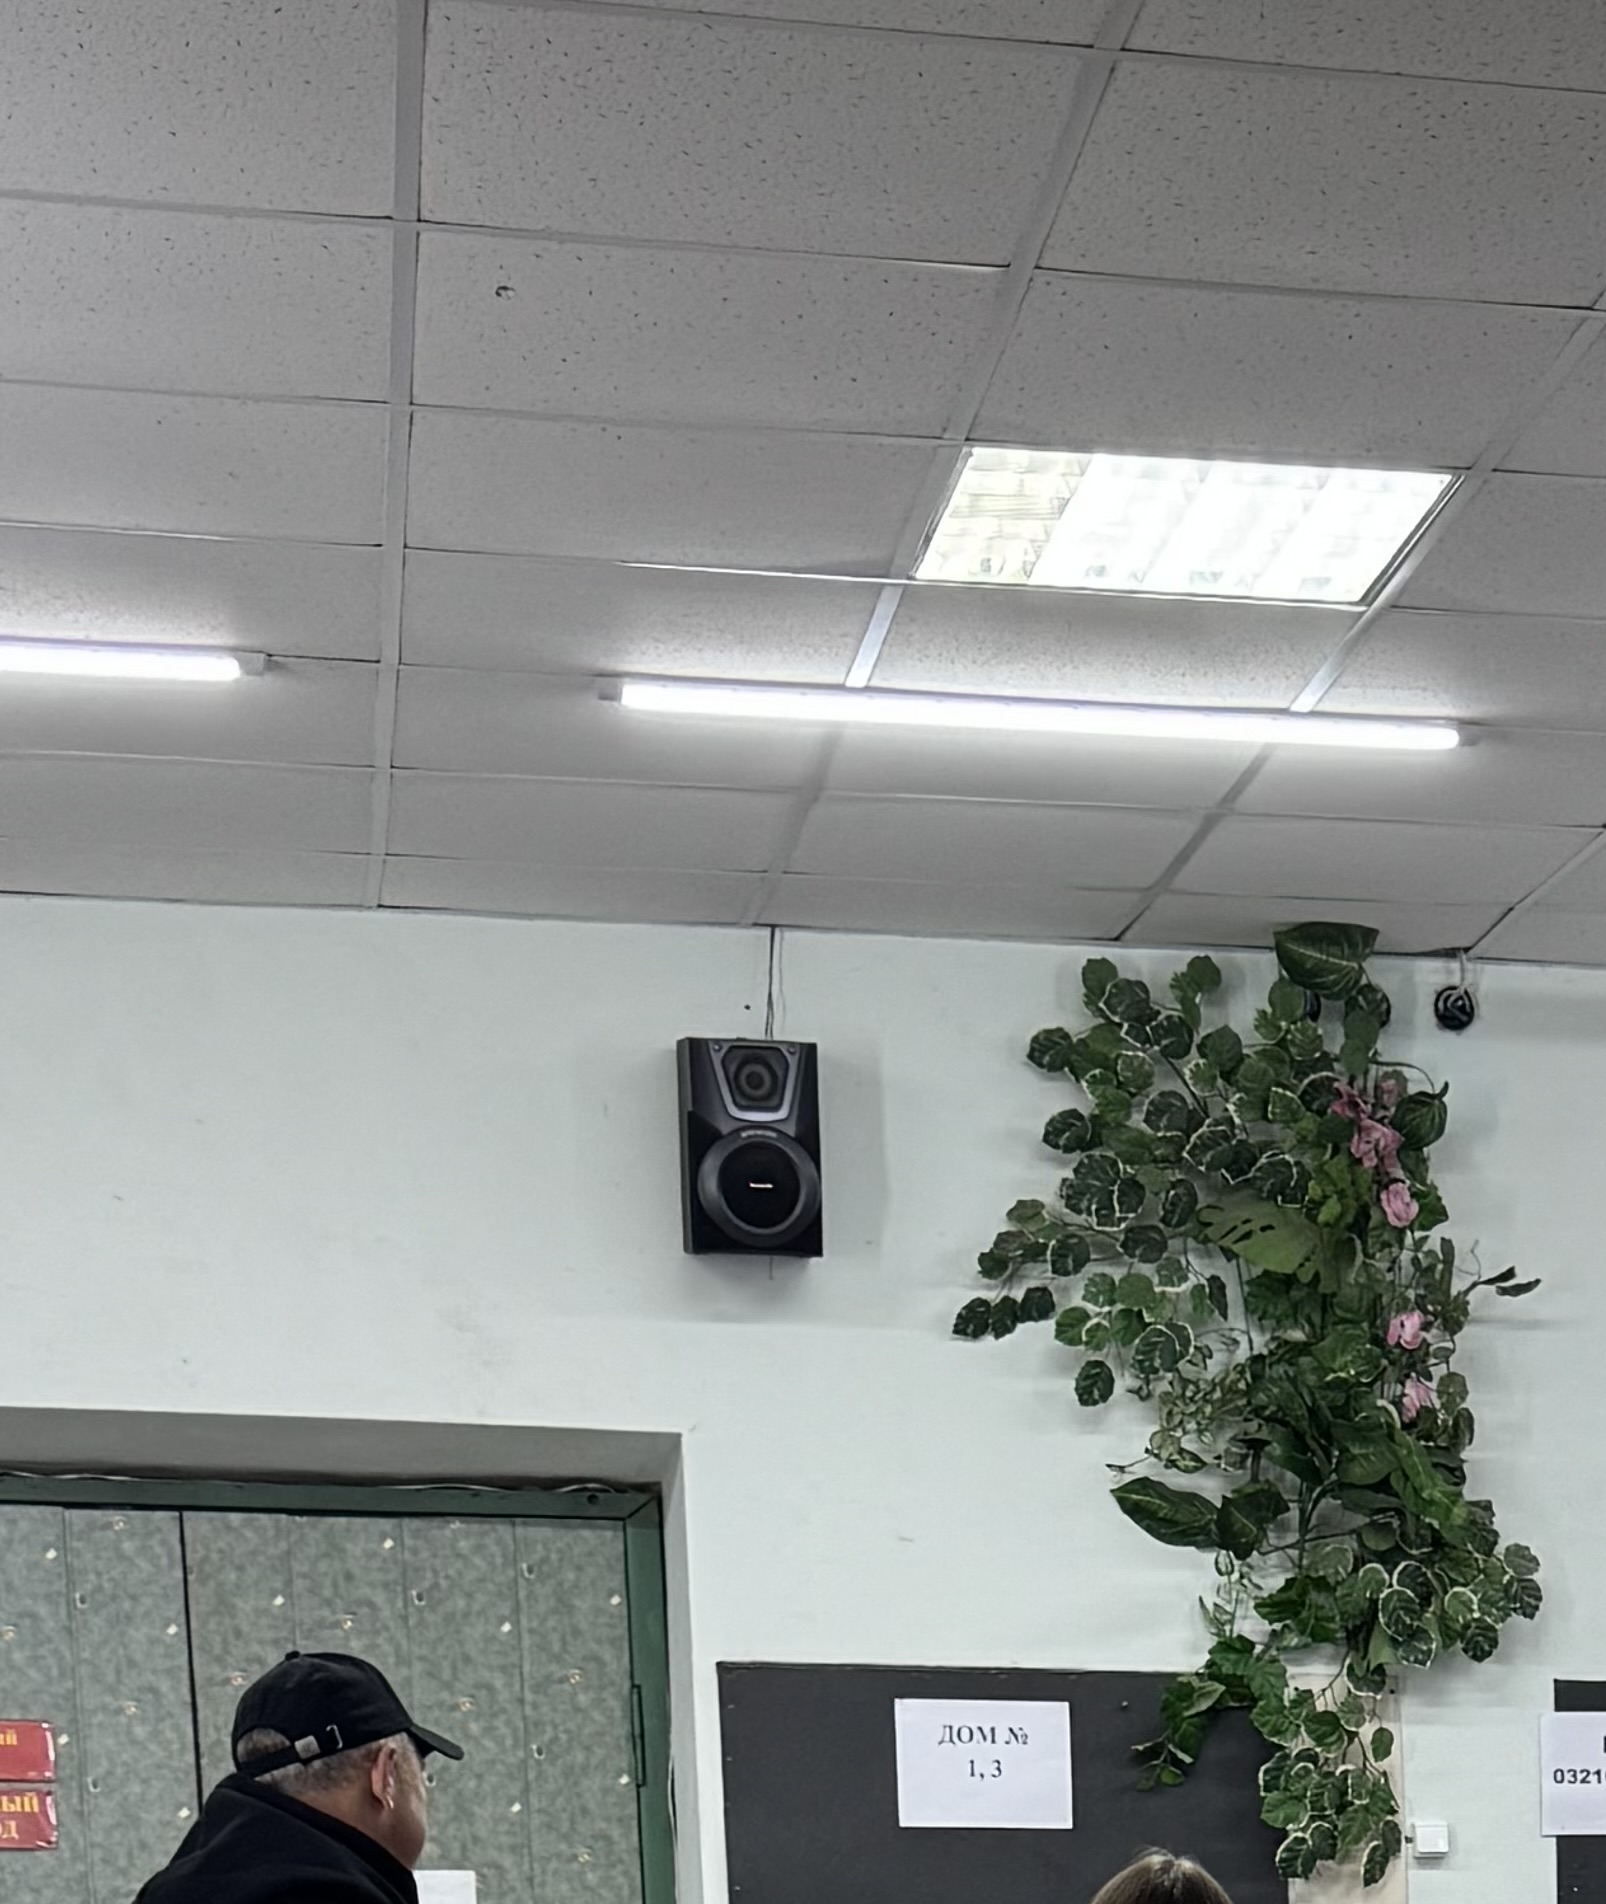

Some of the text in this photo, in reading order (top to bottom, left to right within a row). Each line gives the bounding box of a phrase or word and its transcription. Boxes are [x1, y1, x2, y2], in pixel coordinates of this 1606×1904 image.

[938, 1724, 1029, 1746] ДОМ №
[968, 1759, 1002, 1781] 1, 3
